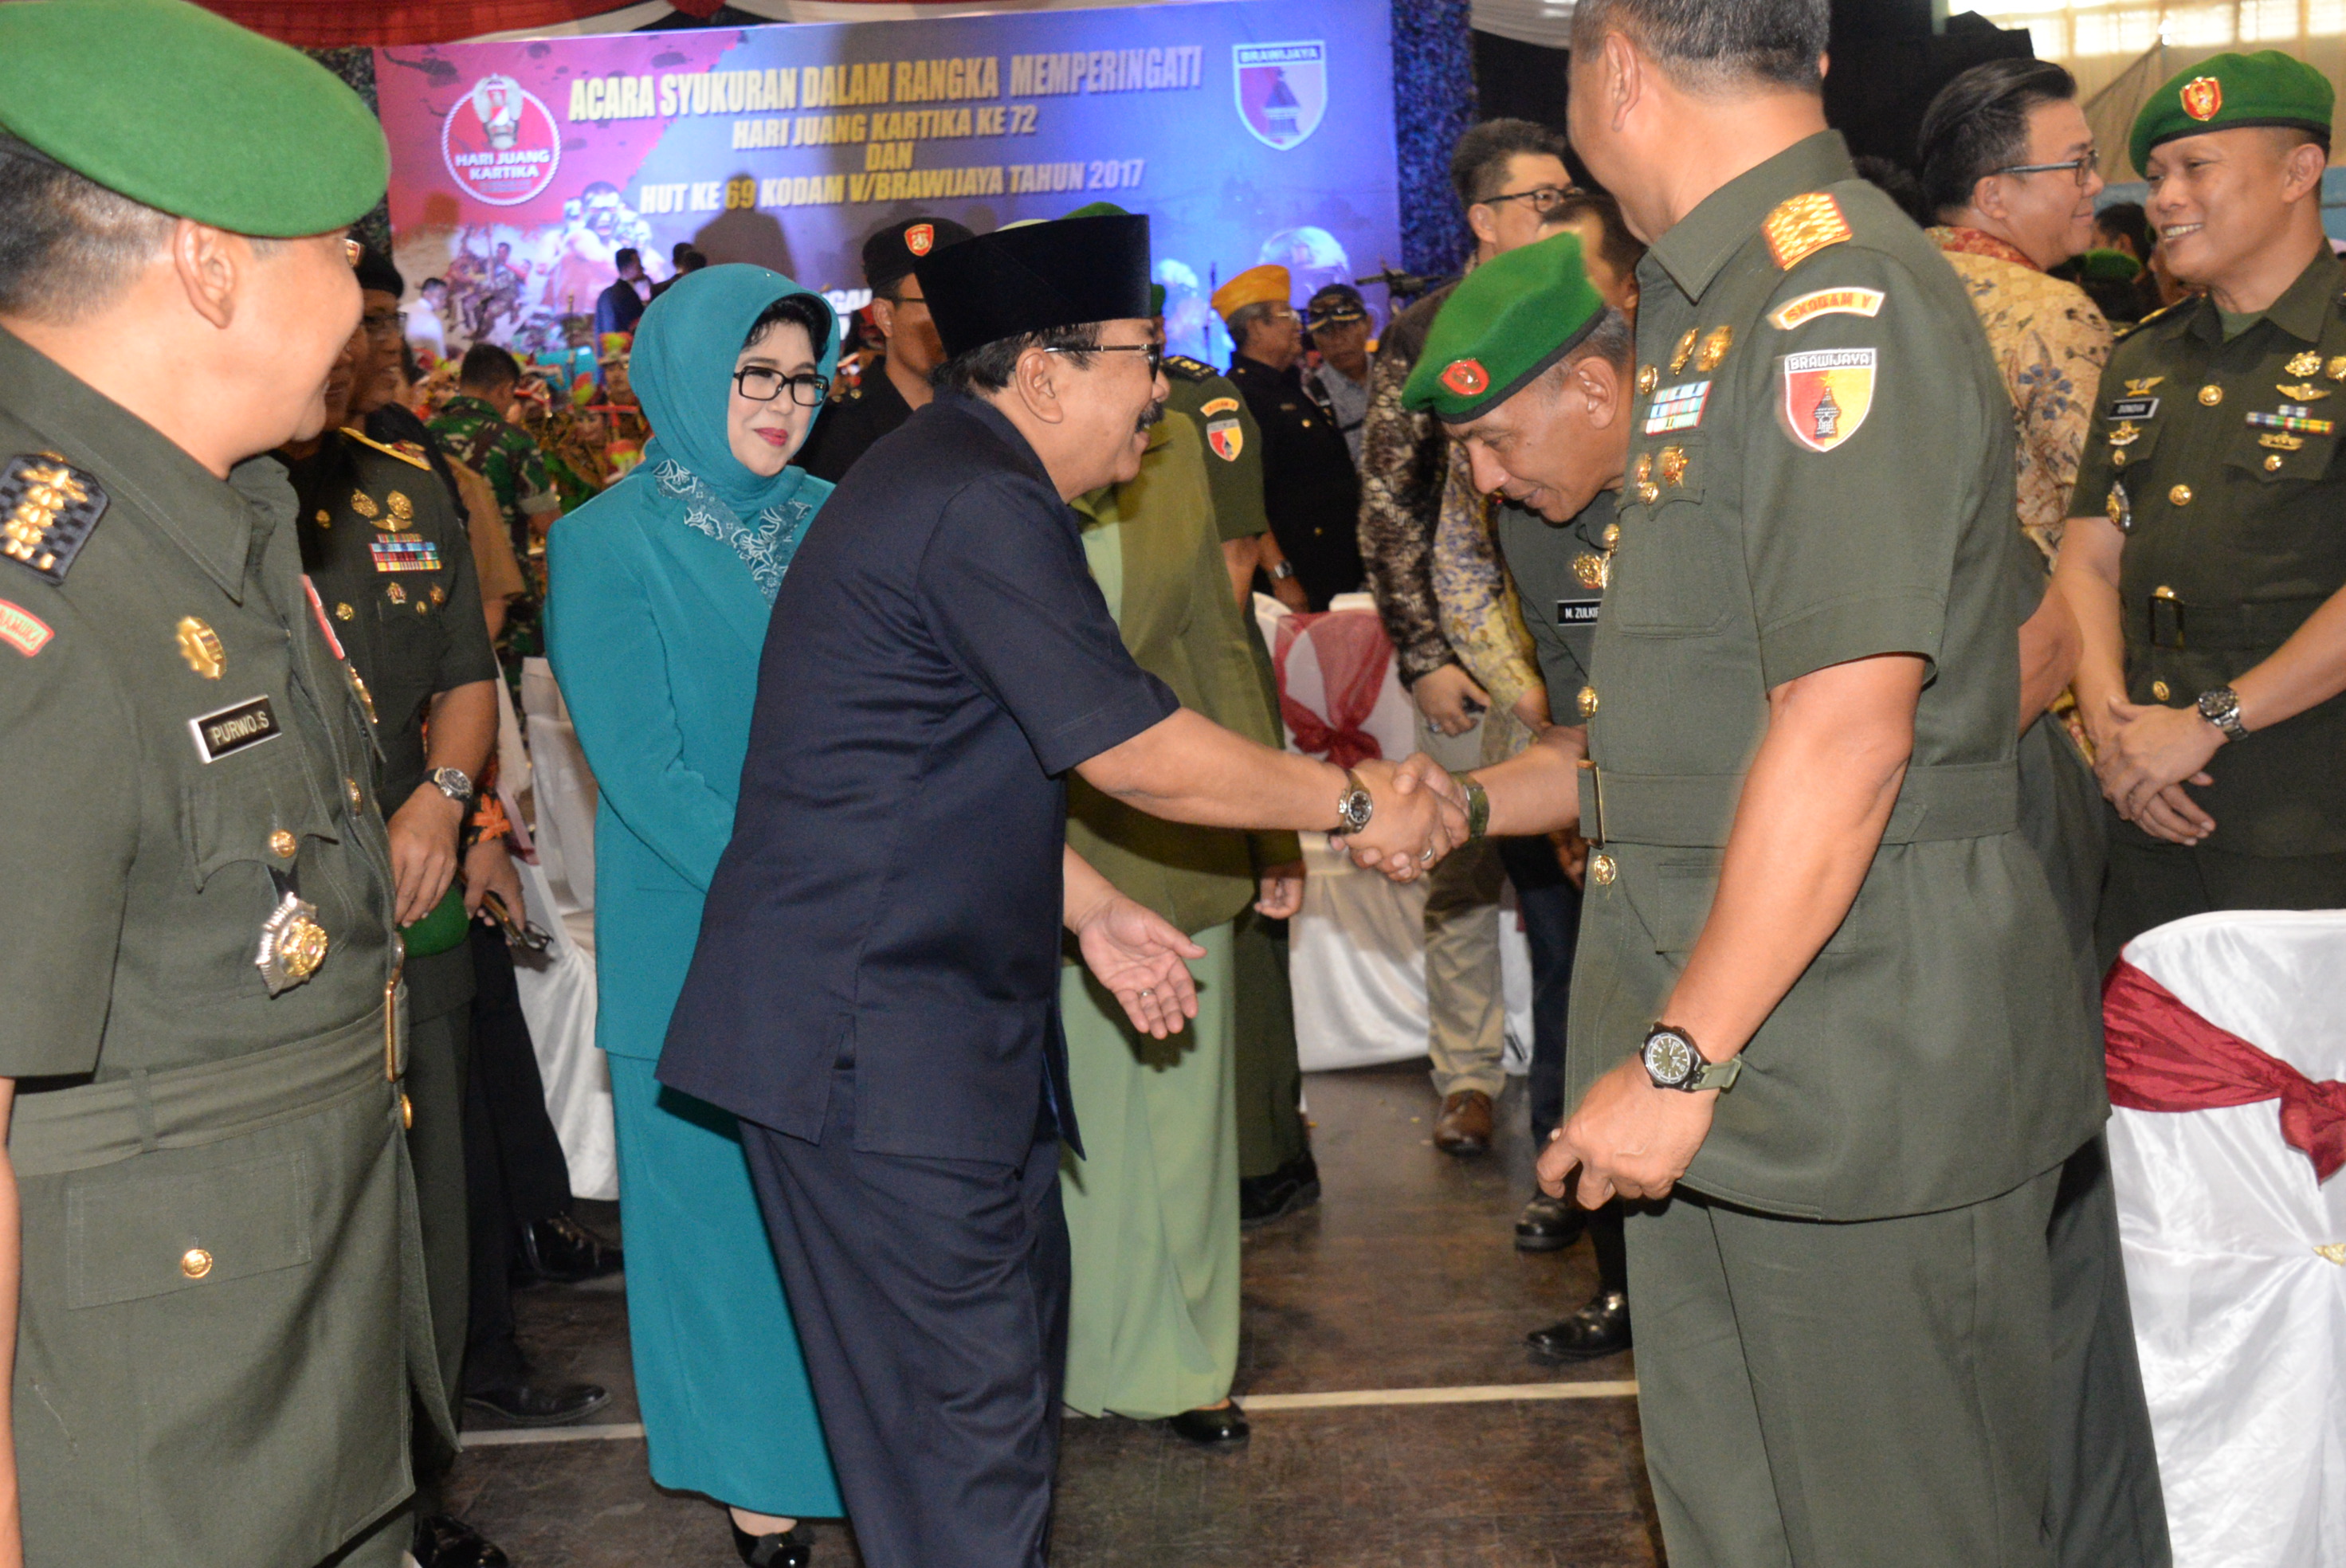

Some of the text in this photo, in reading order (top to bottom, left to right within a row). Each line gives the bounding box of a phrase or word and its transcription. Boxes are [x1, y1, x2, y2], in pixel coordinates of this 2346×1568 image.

[1240, 48, 1317, 63] BRAWIJAYA
[569, 45, 1202, 120] ACARA SYUKURAN DALAM RANGKA MEMPERINGATI
[732, 104, 1038, 149] HARI JUANG KARTIKA KE 72
[455, 149, 551, 167] HARI JUANG
[865, 141, 915, 171] DAN
[469, 164, 540, 180] KARTIKA
[640, 159, 1145, 214] HUT KE 69 KODAM V/BRAWIJAYA TAHUN 2017
[1790, 353, 1870, 370] BRAWIJAYA
